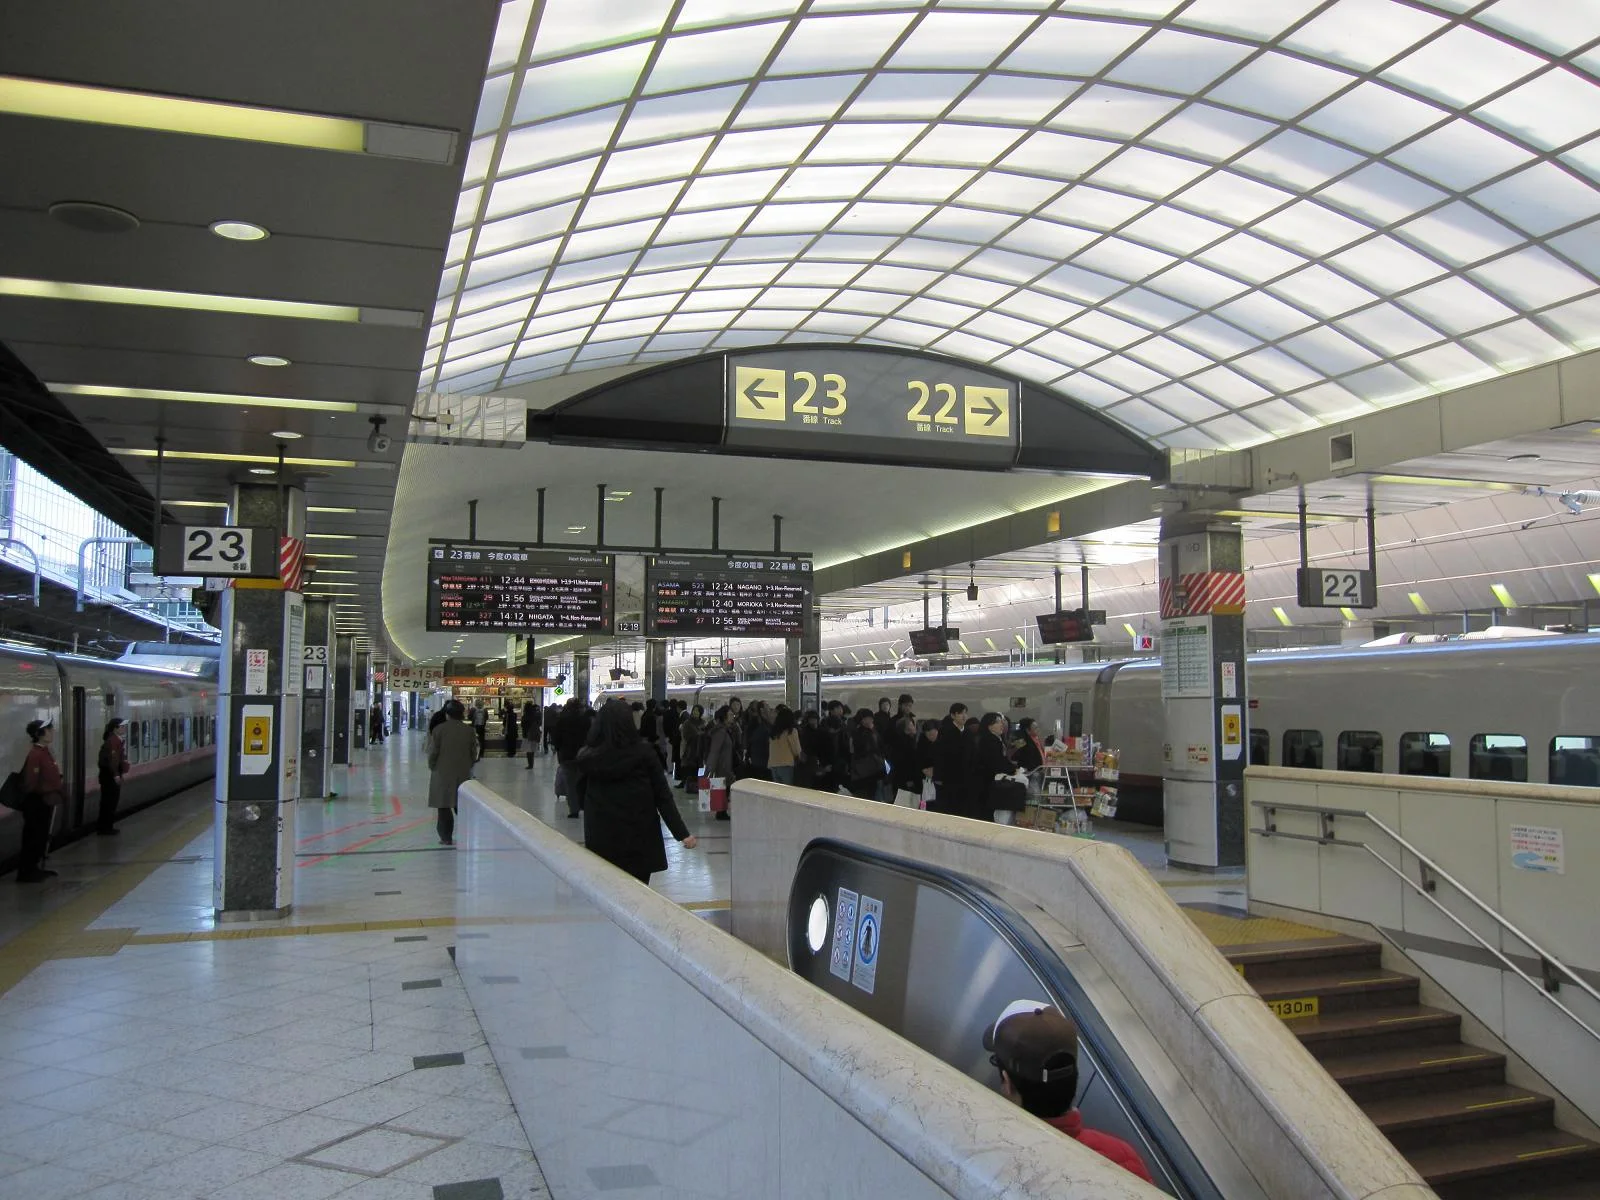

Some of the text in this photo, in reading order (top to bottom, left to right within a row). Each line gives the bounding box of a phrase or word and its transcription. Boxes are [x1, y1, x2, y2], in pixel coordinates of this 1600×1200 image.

[793, 371, 847, 416] 23
[907, 380, 958, 425] 22
[823, 416, 842, 425] Track
[935, 425, 954, 433] Track
[188, 529, 245, 562] 23
[450, 550, 481, 560] 23番線
[770, 562, 796, 570] 22番線
[501, 576, 525, 584] 12:44
[1324, 574, 1358, 597] 22
[500, 594, 524, 602] 13:56
[500, 612, 524, 620] 14:12
[711, 617, 734, 625] 12:56
[303, 646, 327, 660] 23
[697, 656, 710, 666] 22
[800, 655, 819, 668] 22
